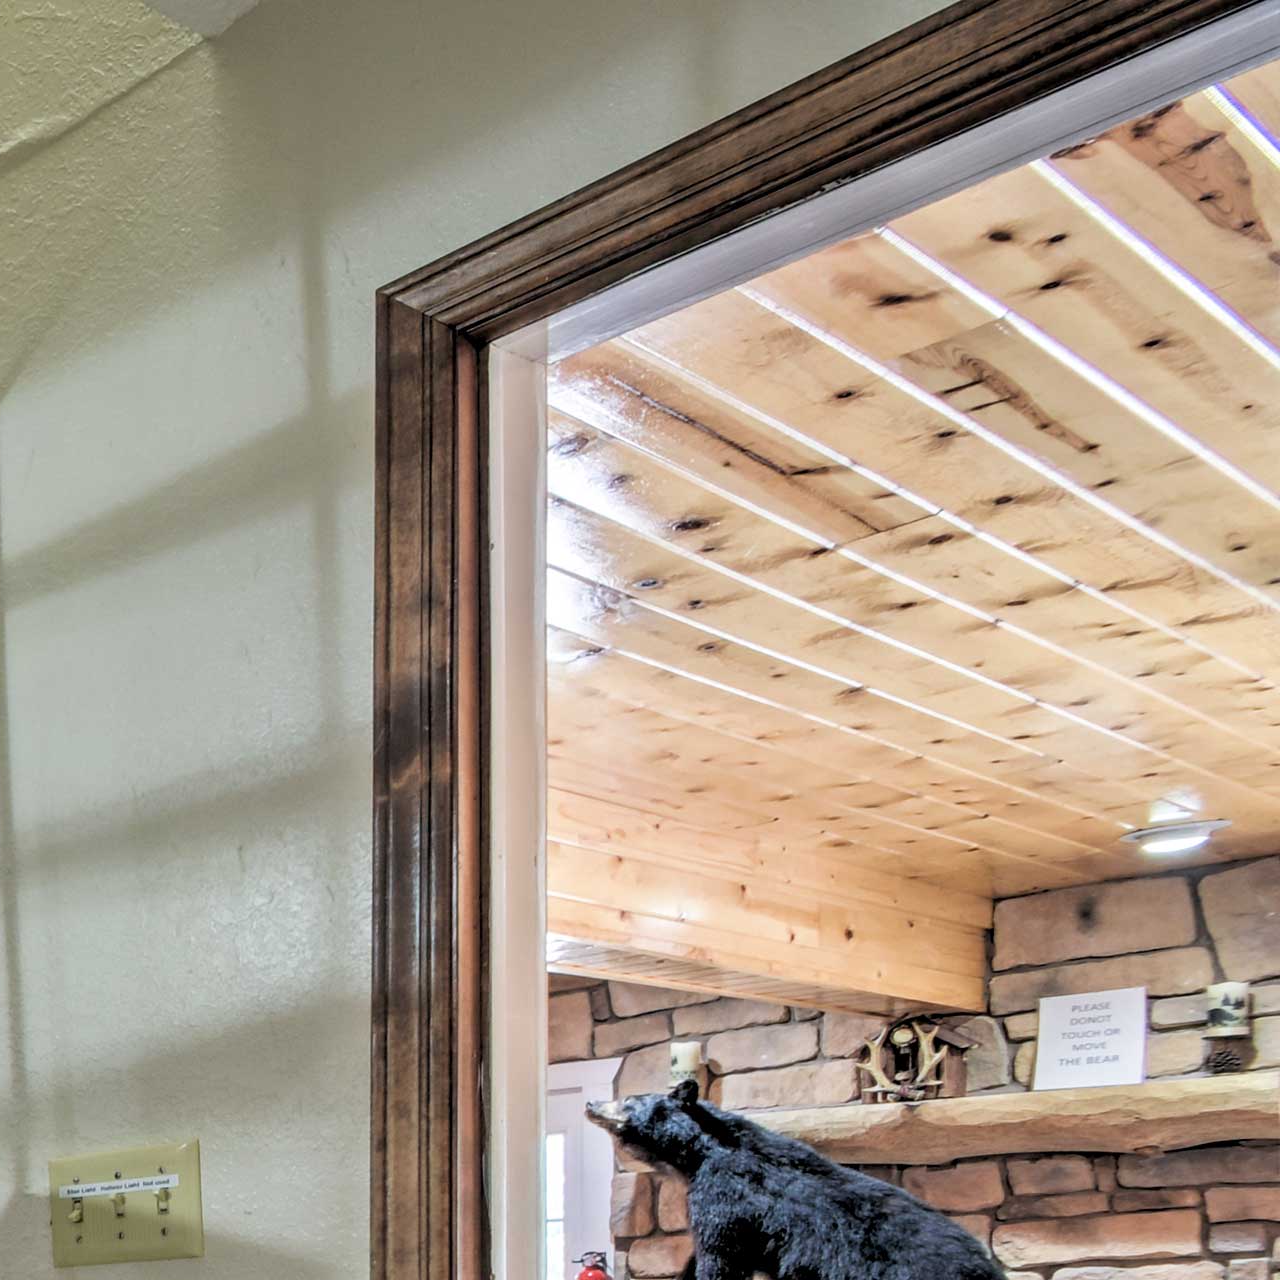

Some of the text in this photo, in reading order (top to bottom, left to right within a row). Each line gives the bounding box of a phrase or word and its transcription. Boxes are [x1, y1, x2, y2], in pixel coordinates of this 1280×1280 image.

[1071, 1002, 1112, 1012] PLEASE
[1061, 1028, 1121, 1040] TOUCH OR
[1072, 1041, 1107, 1051] MOVE
[1059, 1054, 1120, 1067] THE BEAR
